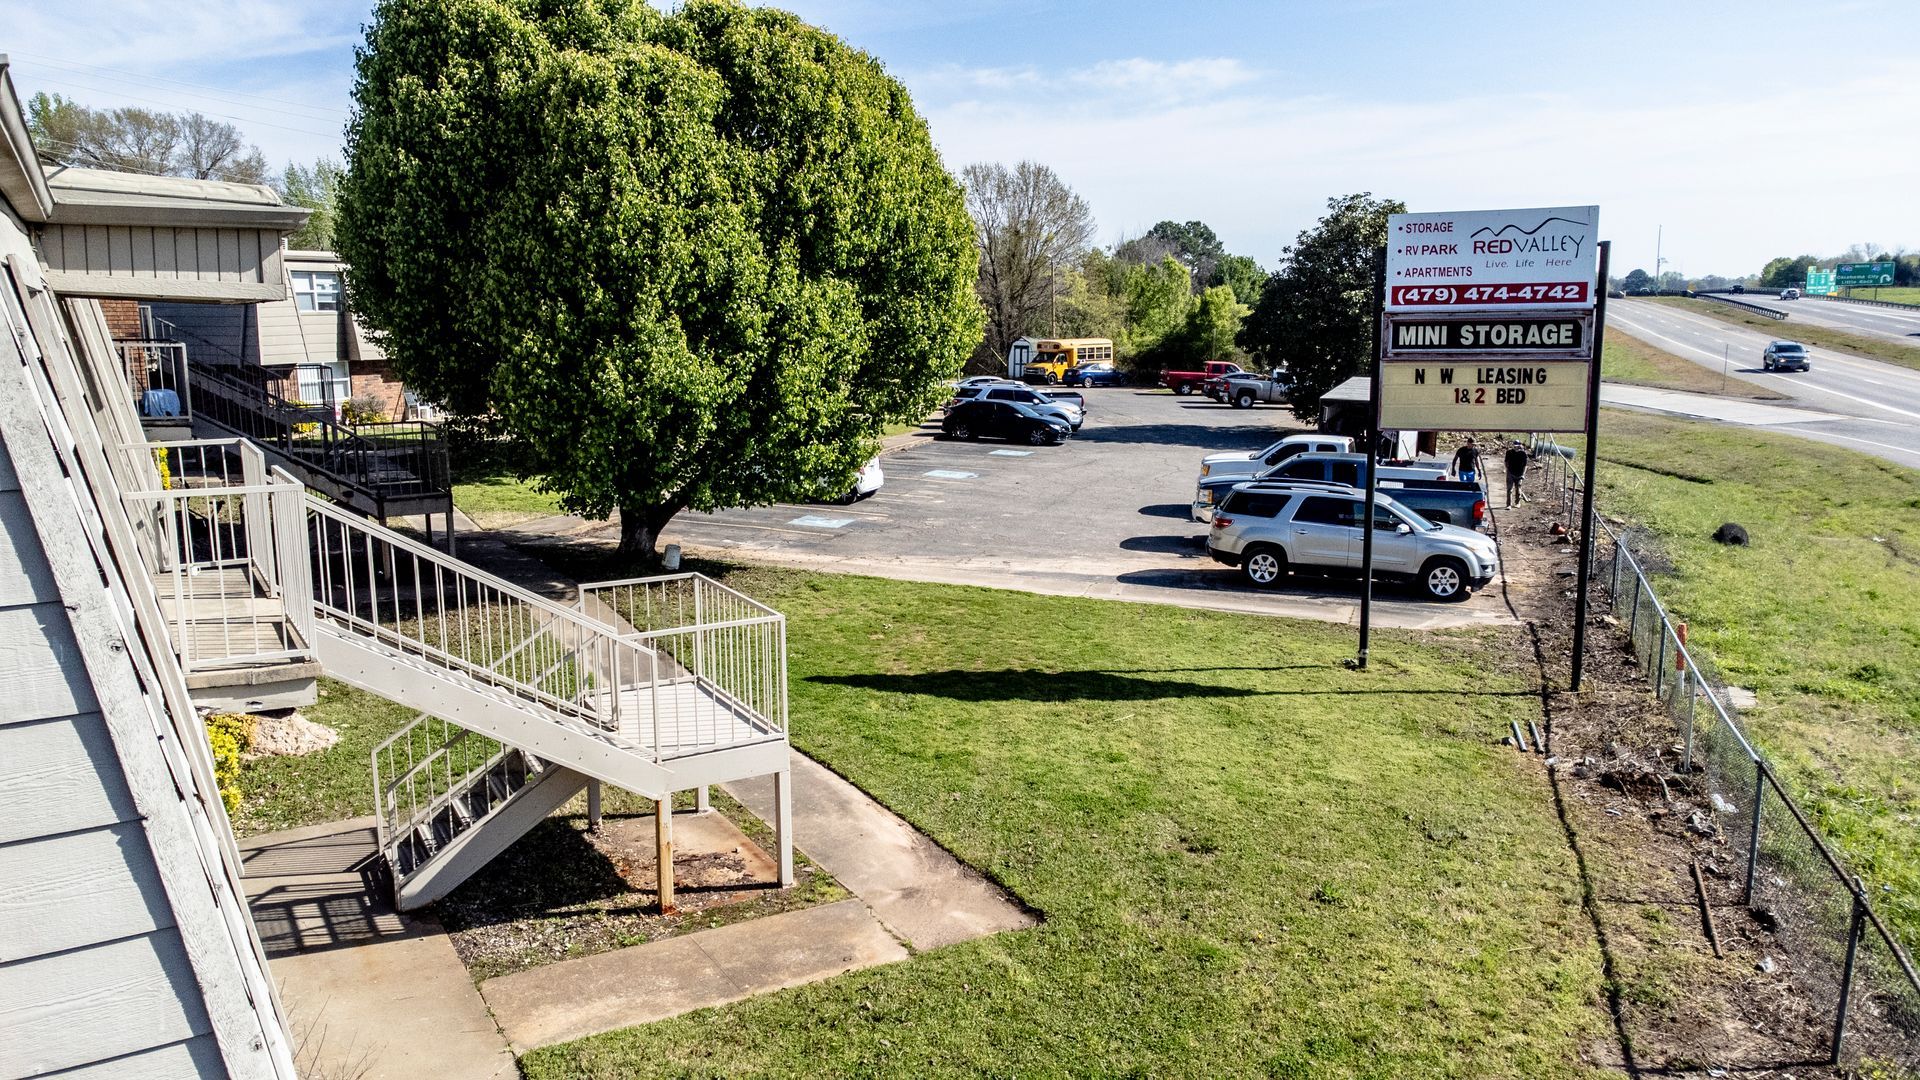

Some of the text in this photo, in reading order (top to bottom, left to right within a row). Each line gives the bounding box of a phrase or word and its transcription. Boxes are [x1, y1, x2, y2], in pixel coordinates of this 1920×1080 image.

[1405, 222, 1453, 233] STORAGE
[1405, 244, 1458, 256] RV PARK
[1515, 259, 1535, 268] Life
[1545, 258, 1572, 267] Here
[1404, 266, 1473, 278] APARTMENTS
[1397, 285, 1580, 305] (479) 474-4742
[1399, 324, 1574, 346] MINI STORAGE
[1477, 367, 1547, 384] LEASING
[1496, 388, 1526, 404] BED
